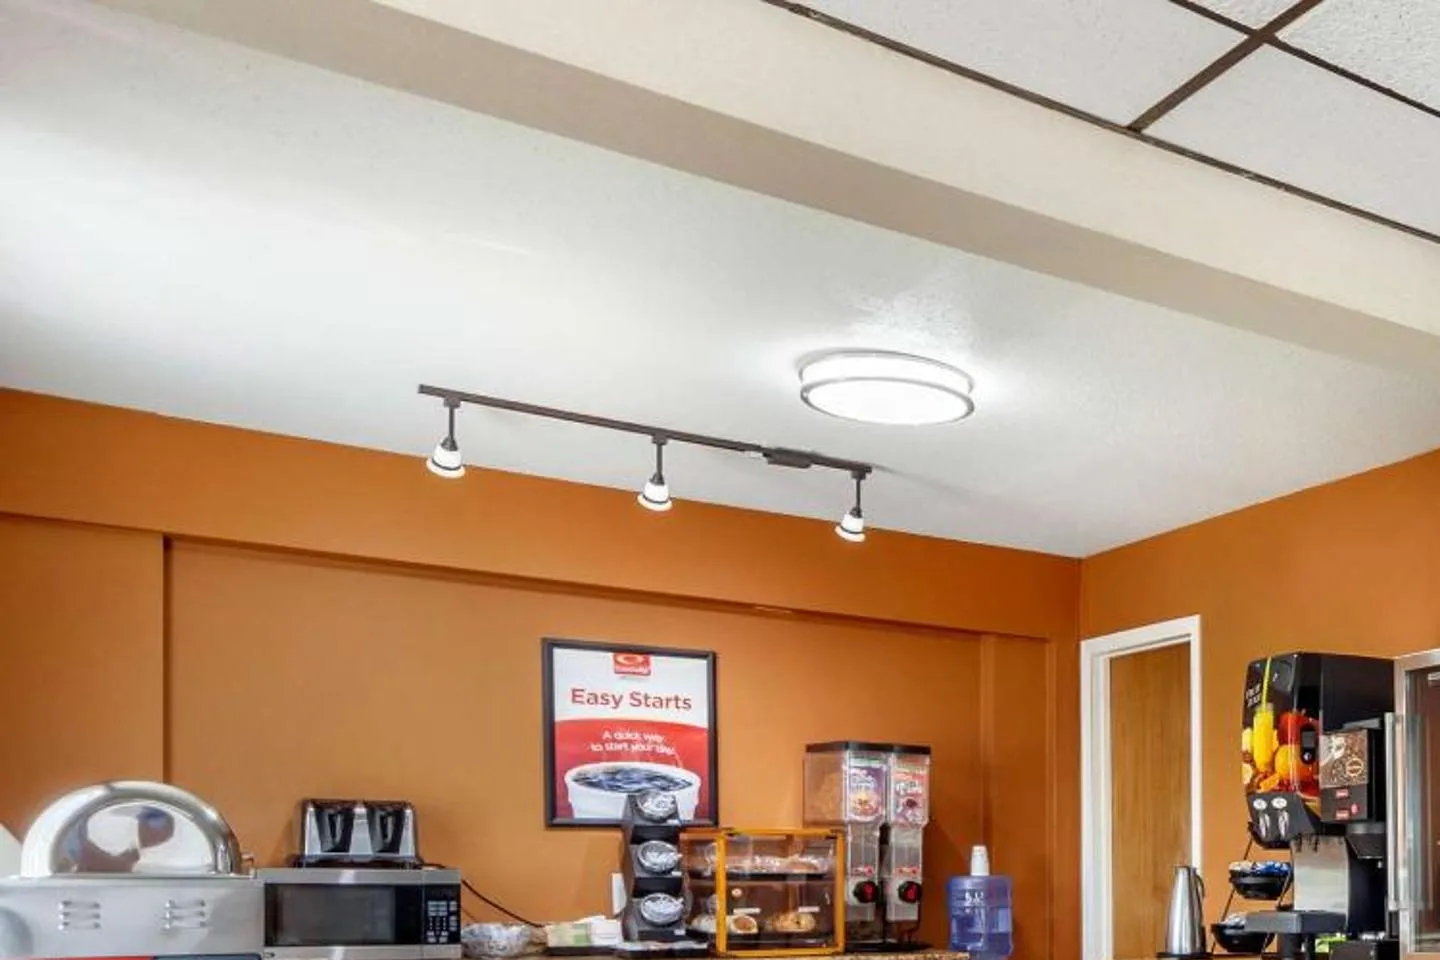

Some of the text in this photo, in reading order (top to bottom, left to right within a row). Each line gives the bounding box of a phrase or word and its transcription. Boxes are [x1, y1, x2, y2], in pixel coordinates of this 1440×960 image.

[571, 688, 692, 710] Easy Starts
[602, 730, 612, 740] A
[614, 730, 640, 742] quick
[590, 743, 603, 752] to
